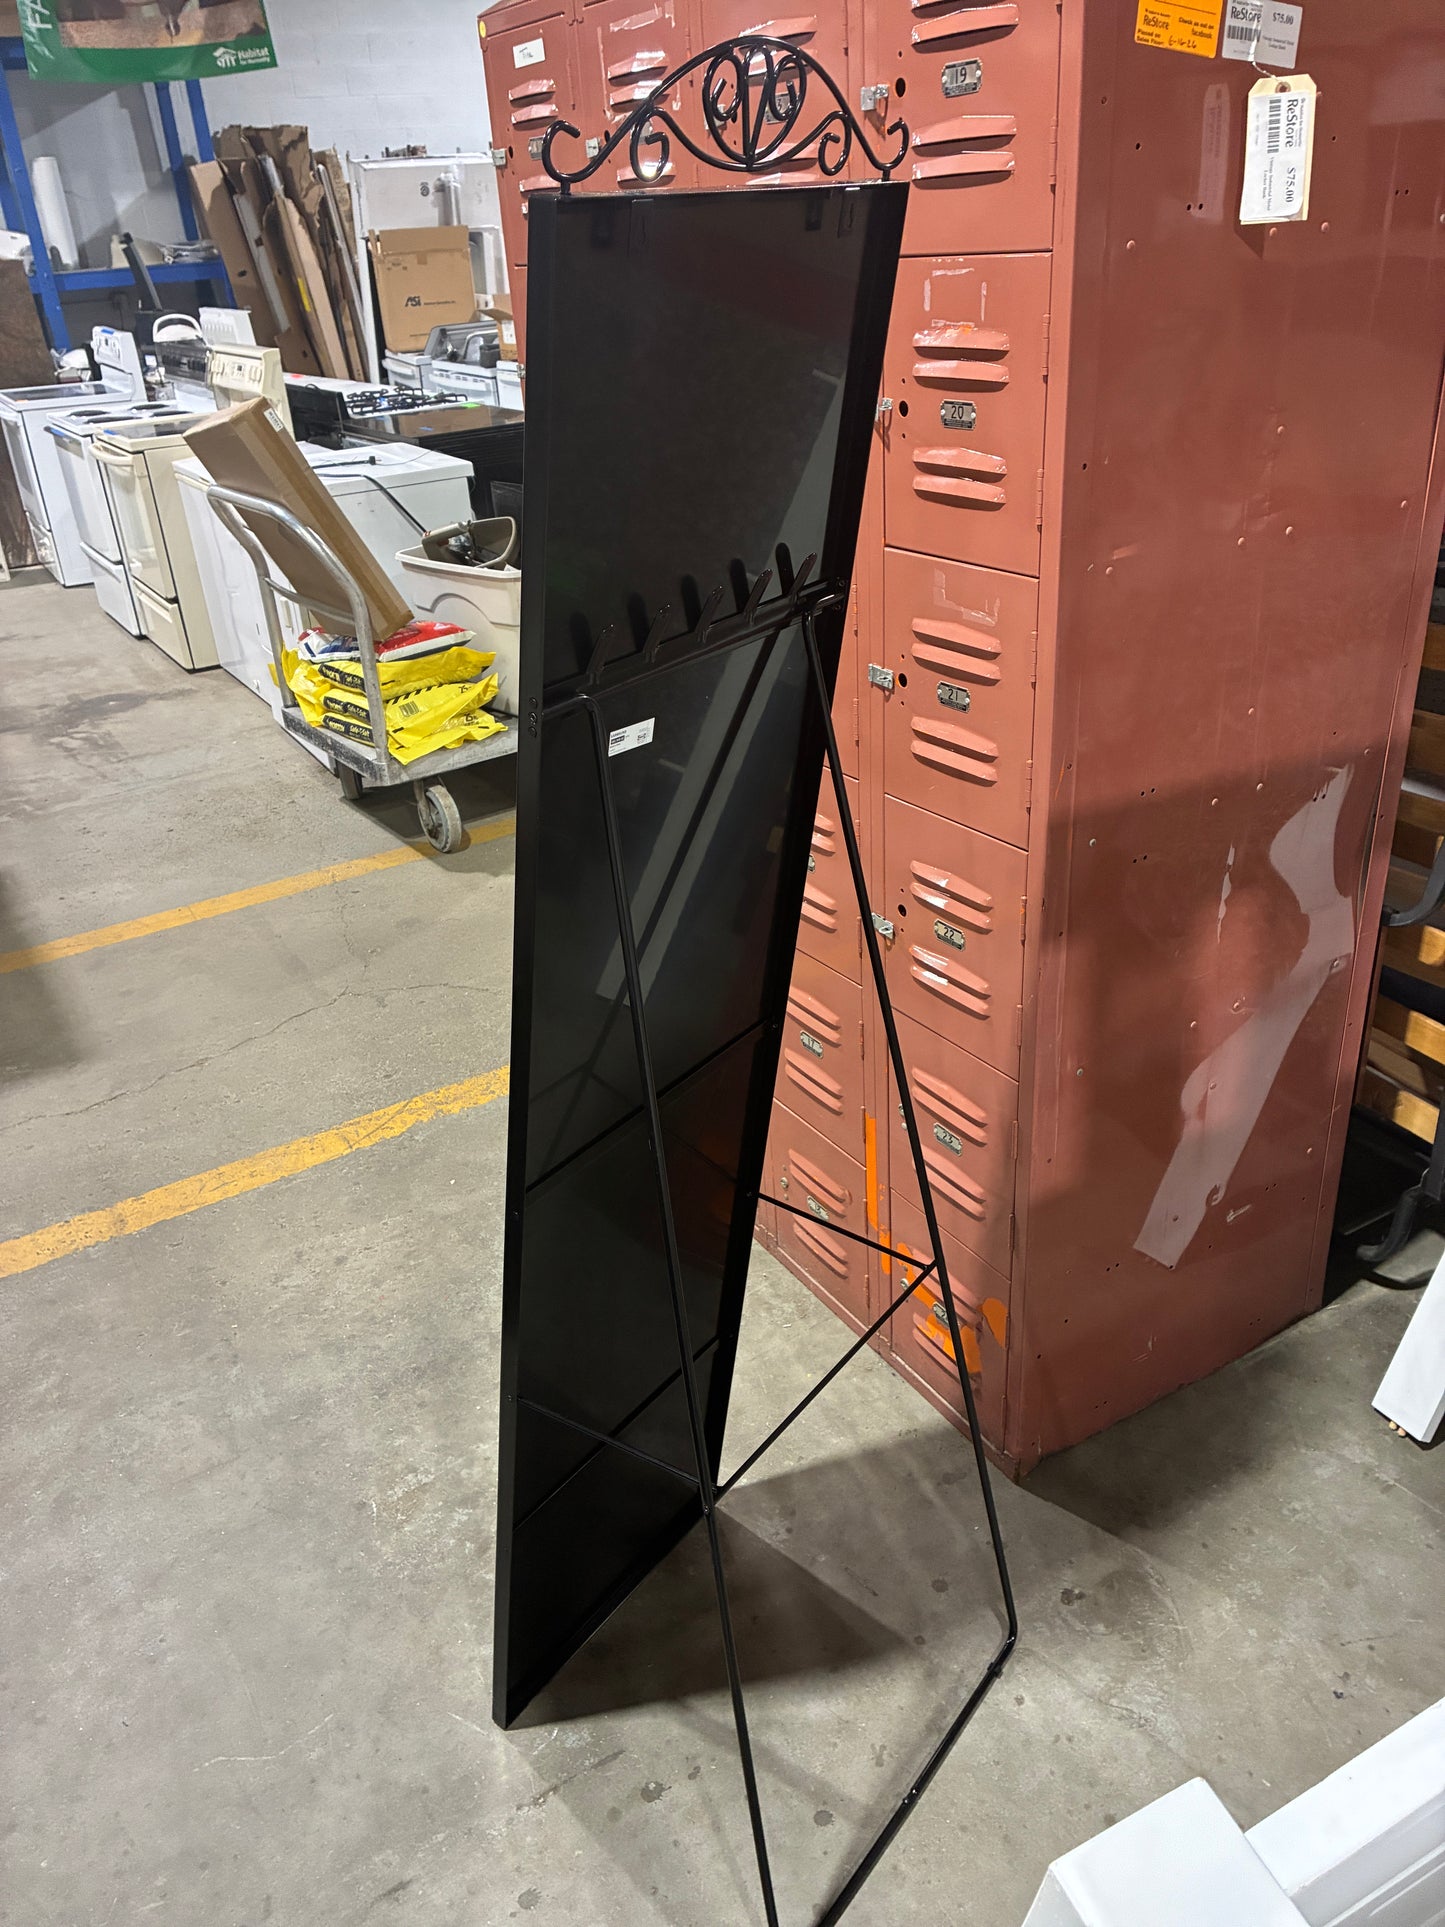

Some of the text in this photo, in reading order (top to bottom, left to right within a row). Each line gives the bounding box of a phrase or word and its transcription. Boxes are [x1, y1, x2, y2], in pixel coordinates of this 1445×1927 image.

[1142, 14, 1170, 30] ReStore
[1230, 6, 1262, 23] ReStore
[1272, 12, 1295, 25] $75.00
[955, 66, 967, 84] 19
[1284, 98, 1299, 148] ReStore
[1285, 167, 1296, 203] $75.00
[951, 405, 964, 420] 20
[948, 688, 958, 701] 21
[944, 926, 954, 941] 22
[943, 1130, 953, 1144] 23
